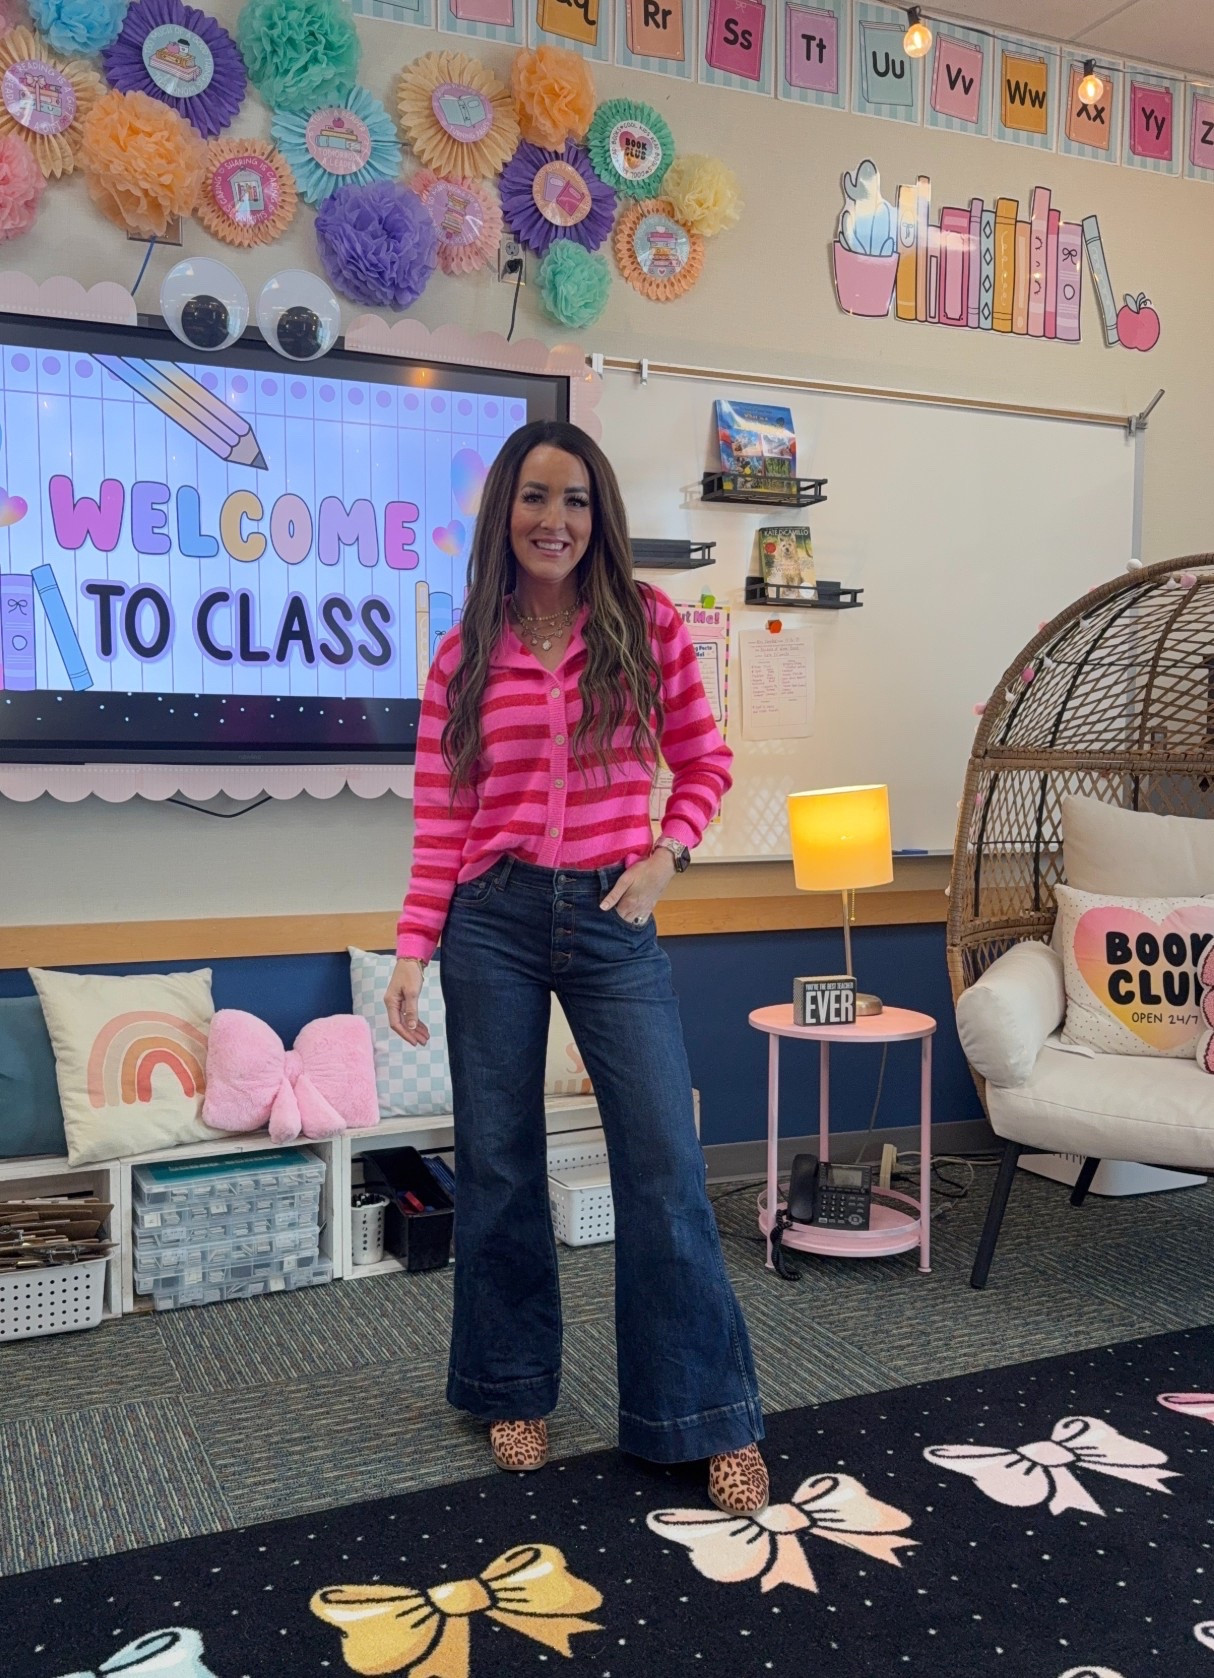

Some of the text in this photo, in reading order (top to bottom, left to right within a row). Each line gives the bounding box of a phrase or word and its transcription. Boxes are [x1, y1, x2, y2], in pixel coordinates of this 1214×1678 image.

[642, 0, 673, 30] Rr
[722, 17, 753, 51] Ss
[801, 33, 827, 64] Tt
[17, 61, 55, 77] READING
[872, 51, 905, 79] Uu
[945, 64, 974, 96] Vv
[1006, 78, 1046, 109] Ww
[1141, 106, 1166, 141] Yy
[624, 137, 647, 161] BOOK CLUB
[214, 176, 228, 204] CARING
[224, 157, 279, 203] SHARING IS CARING
[49, 474, 420, 570] WELCOME
[85, 583, 392, 666] TO CLASS
[693, 611, 721, 625] Me!
[805, 990, 854, 1024] EVER
[1132, 1012, 1199, 1026] OPEN 24/7
